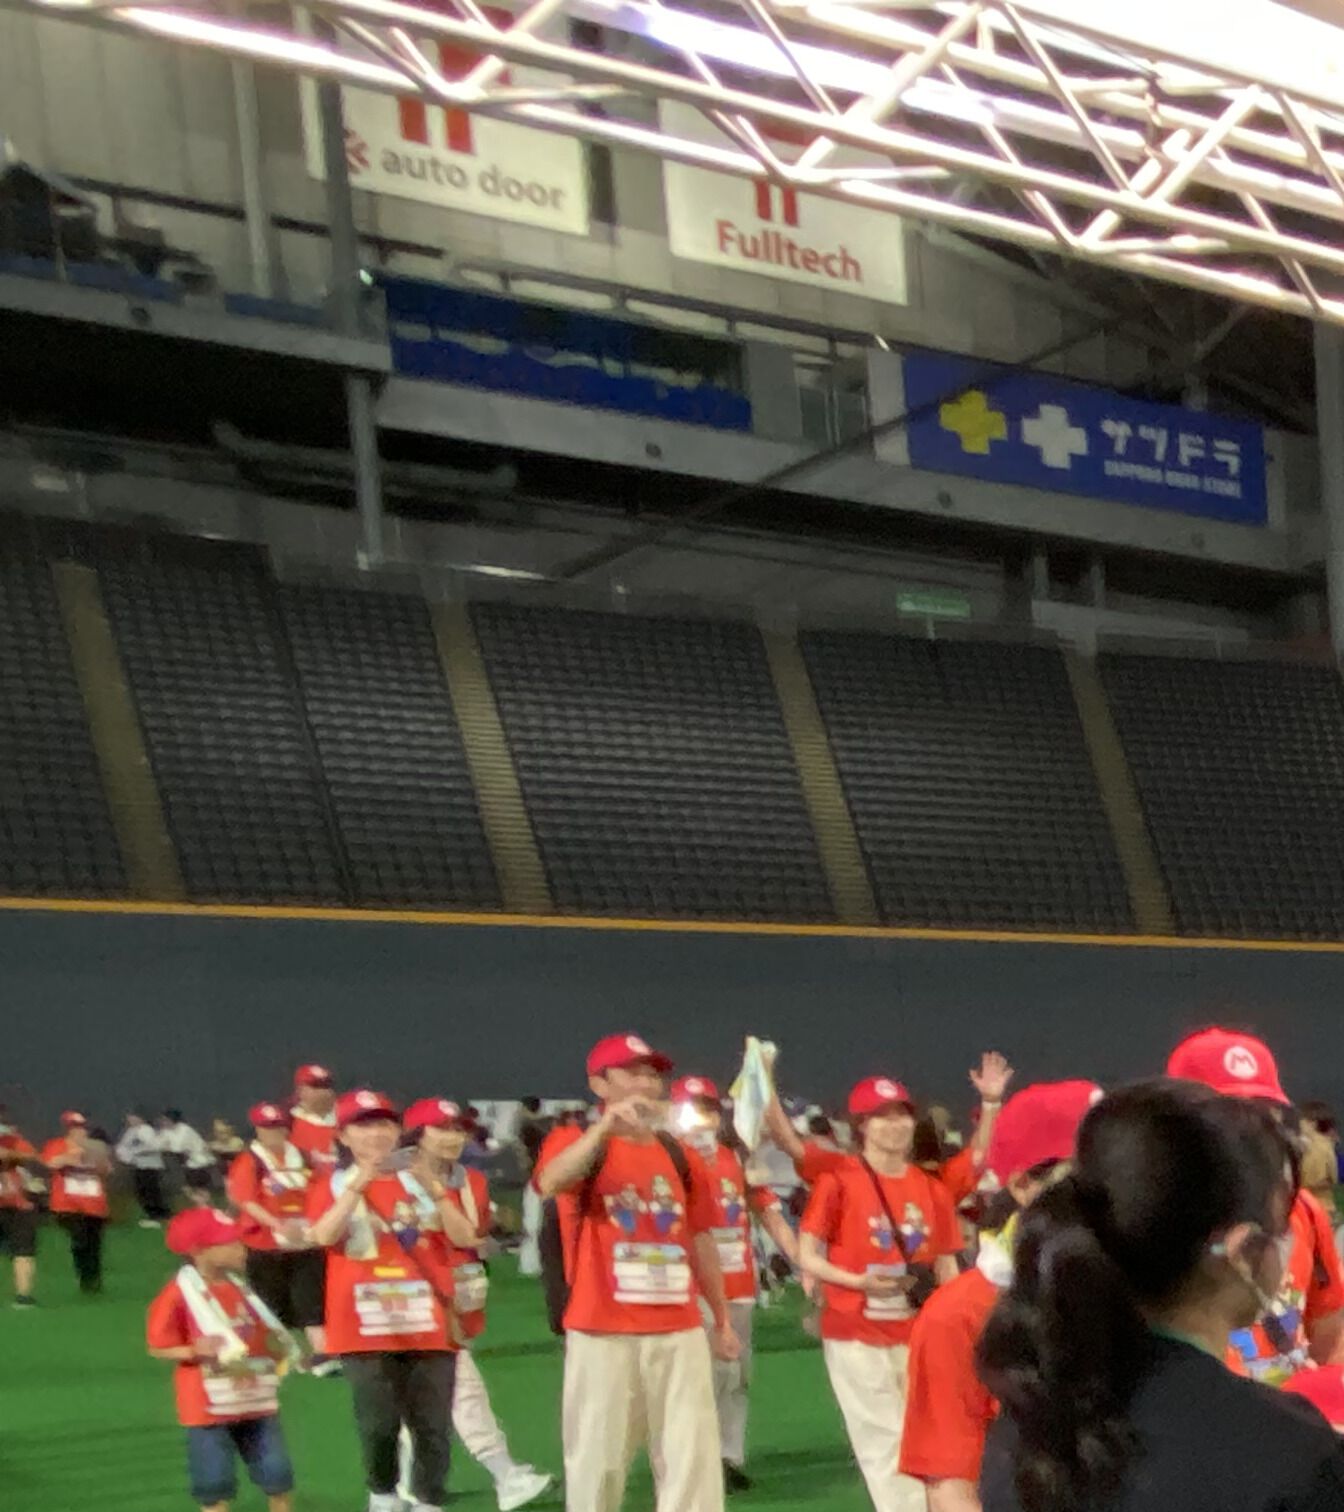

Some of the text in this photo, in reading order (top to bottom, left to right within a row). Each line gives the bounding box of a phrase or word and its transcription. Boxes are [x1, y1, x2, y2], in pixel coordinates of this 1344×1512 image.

[381, 150, 470, 189] auto
[479, 163, 567, 211] door
[716, 218, 865, 285] Fulltech
